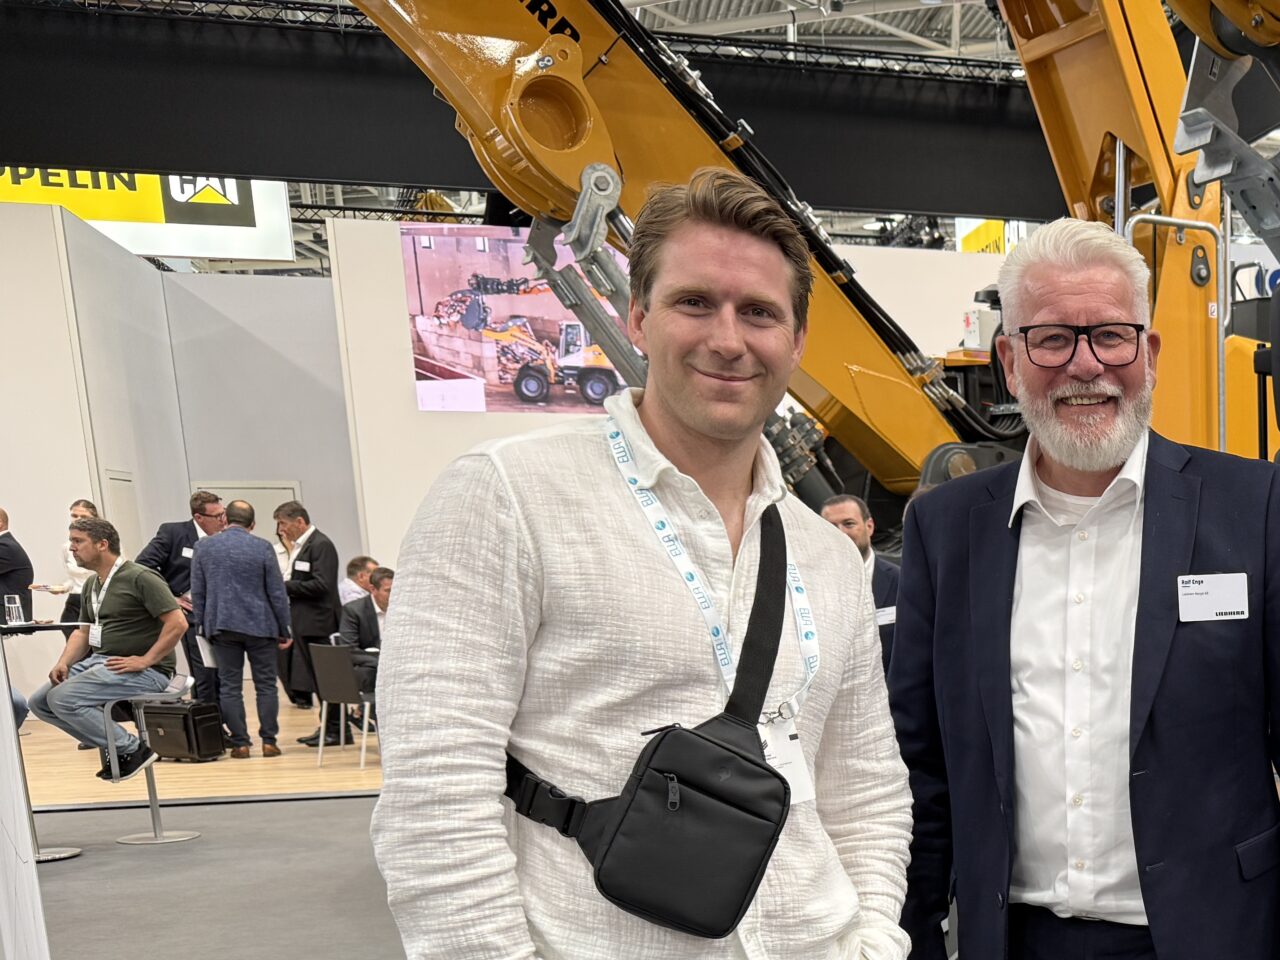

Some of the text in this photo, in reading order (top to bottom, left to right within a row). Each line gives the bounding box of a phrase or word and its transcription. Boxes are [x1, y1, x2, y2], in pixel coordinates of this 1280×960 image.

[0, 166, 137, 192] PELIN
[661, 533, 682, 557] ELLA
[692, 585, 711, 611] ELLA
[715, 641, 730, 667] ELLA
